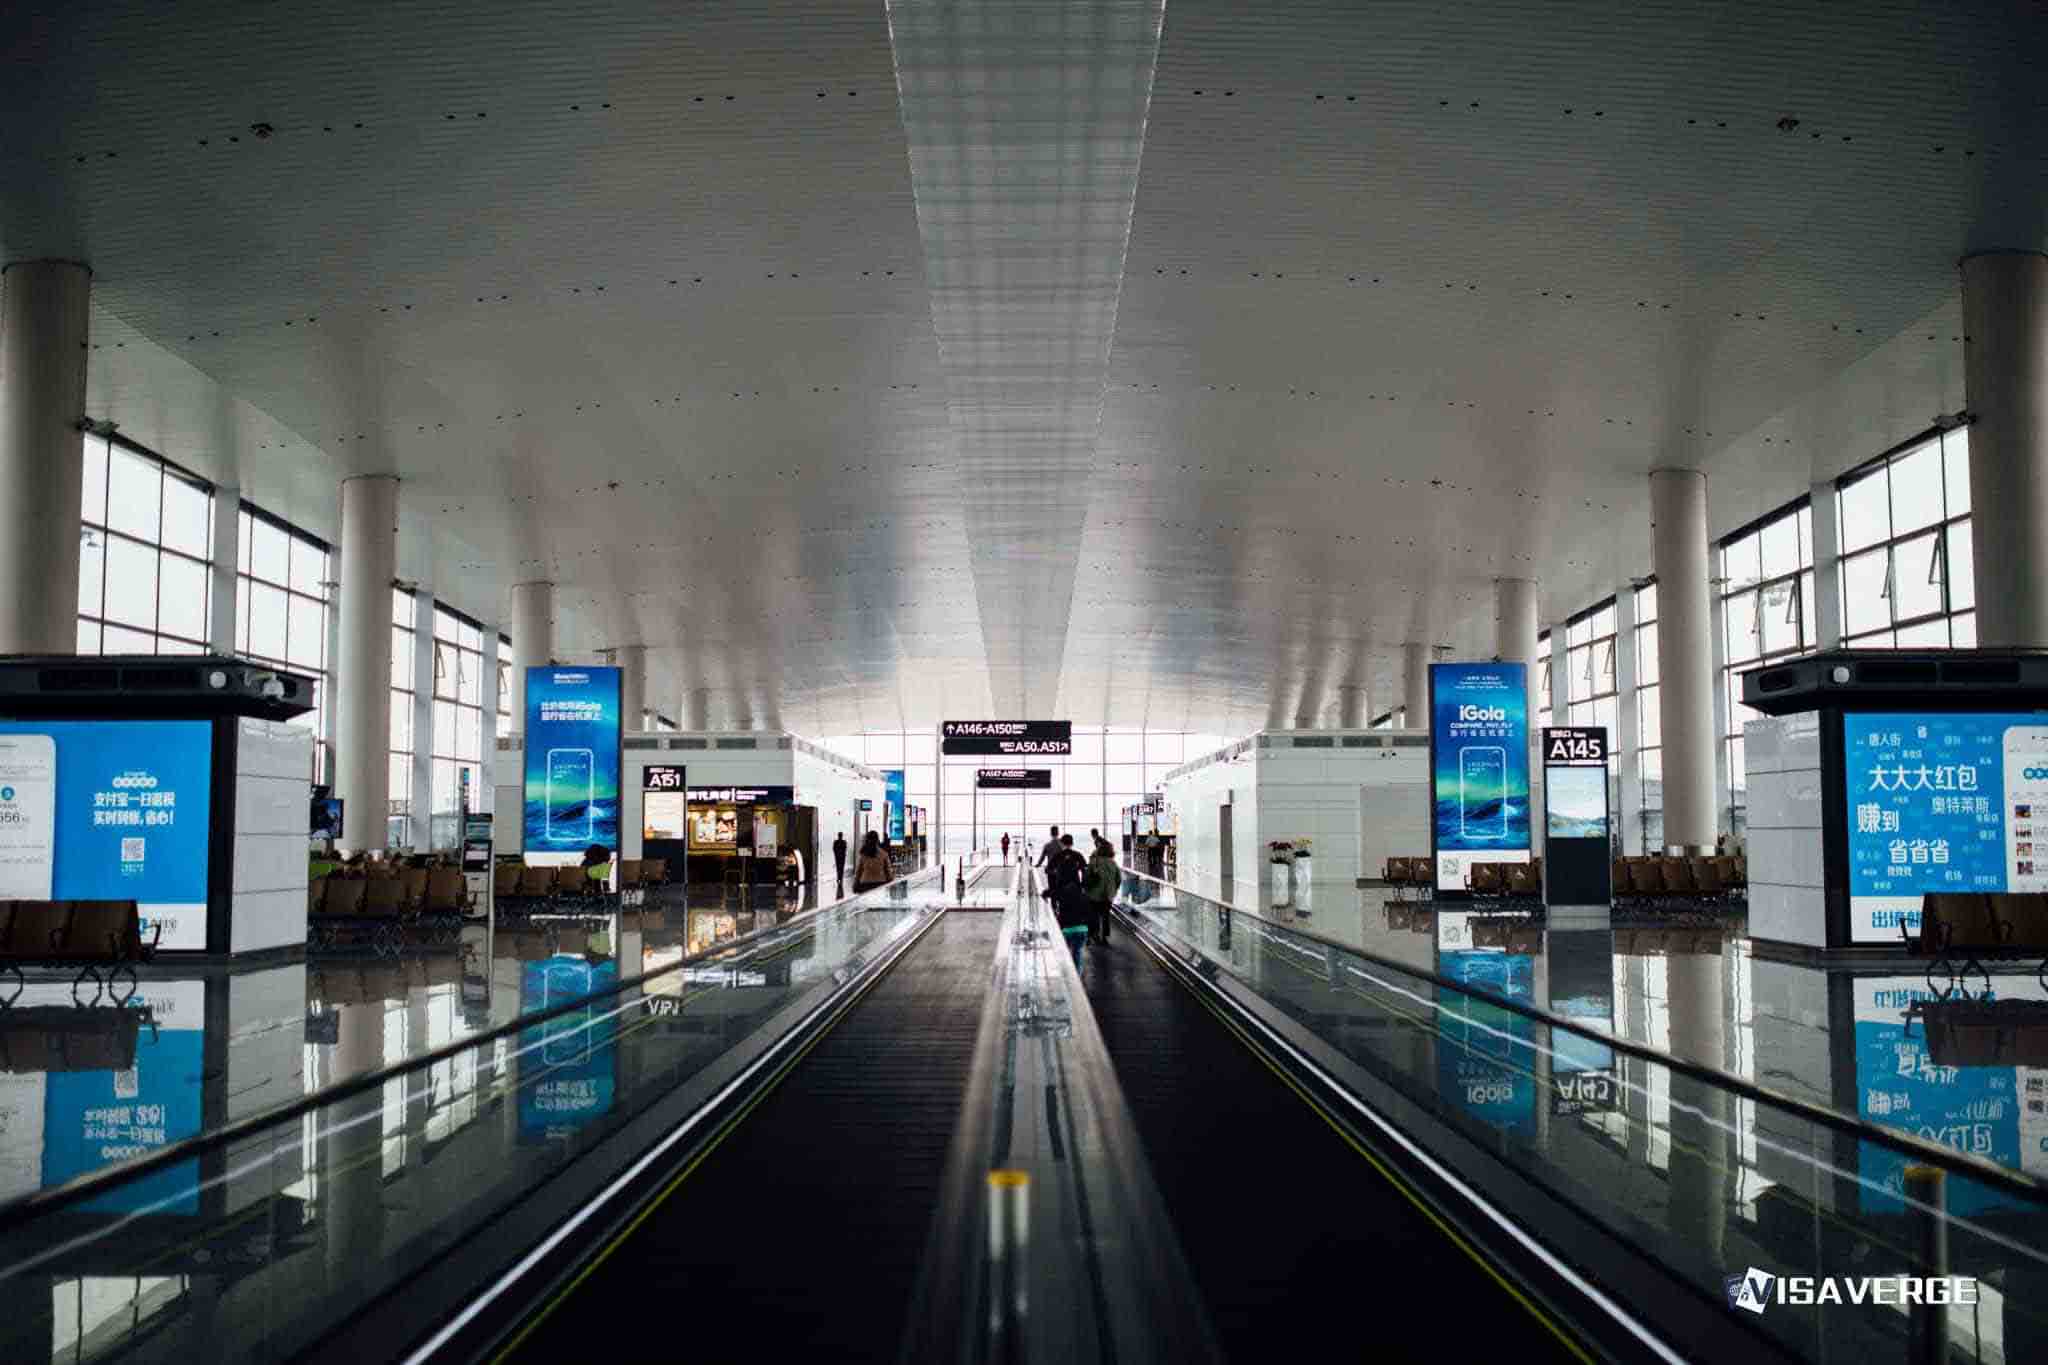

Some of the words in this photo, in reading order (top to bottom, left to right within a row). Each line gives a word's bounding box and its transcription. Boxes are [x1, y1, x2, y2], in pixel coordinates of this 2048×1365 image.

[1550, 739, 1601, 759] A145
[1868, 763, 1978, 792] 大大大红包
[1857, 803, 1899, 833] 赚到
[1931, 797, 1989, 815] 奥特莱斯
[1889, 838, 1949, 864] 省省省
